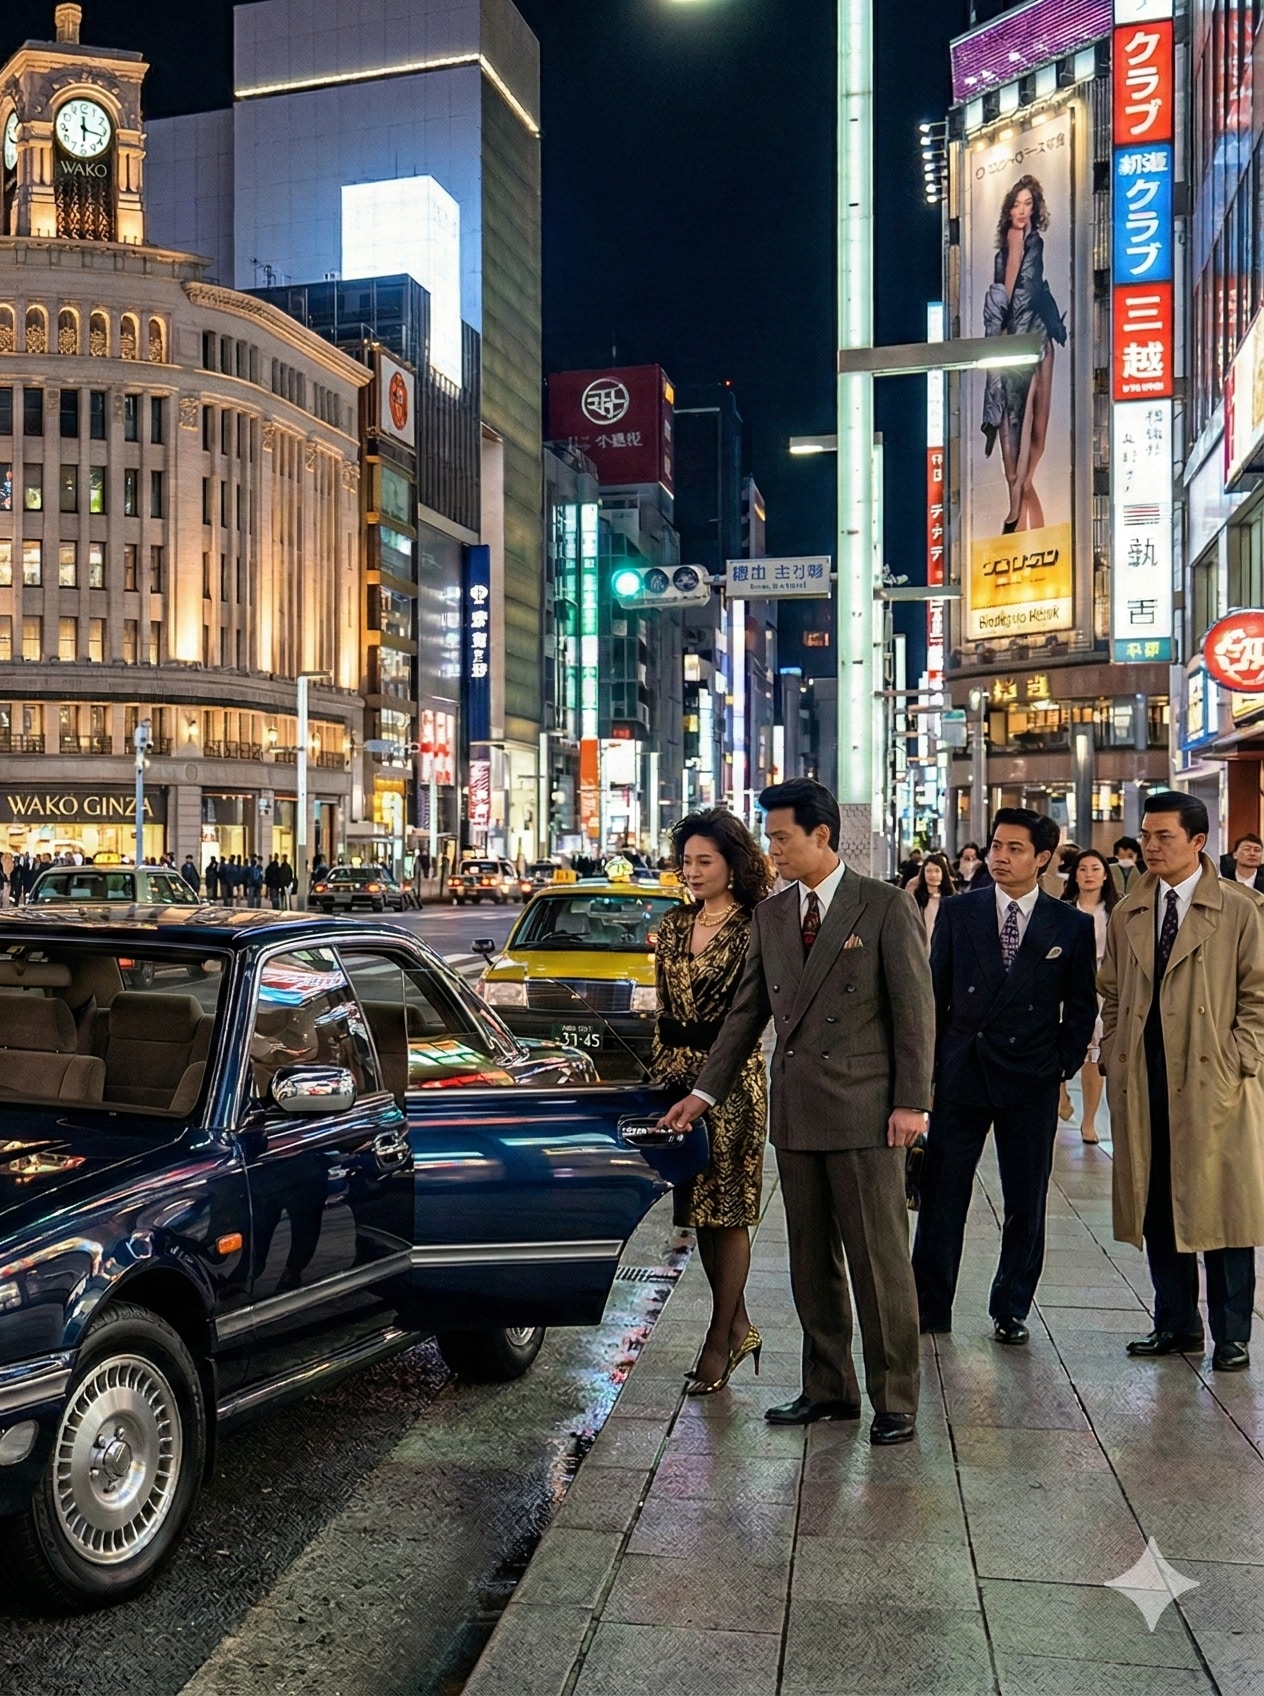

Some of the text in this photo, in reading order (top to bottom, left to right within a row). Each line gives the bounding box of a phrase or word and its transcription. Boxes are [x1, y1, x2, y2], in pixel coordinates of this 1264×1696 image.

[1124, 31, 1163, 135] クラブ
[60, 160, 108, 178] WAKO
[1125, 178, 1163, 276] クラブ
[1122, 295, 1165, 378] 三越
[7, 795, 154, 817] WAKO GINZA
